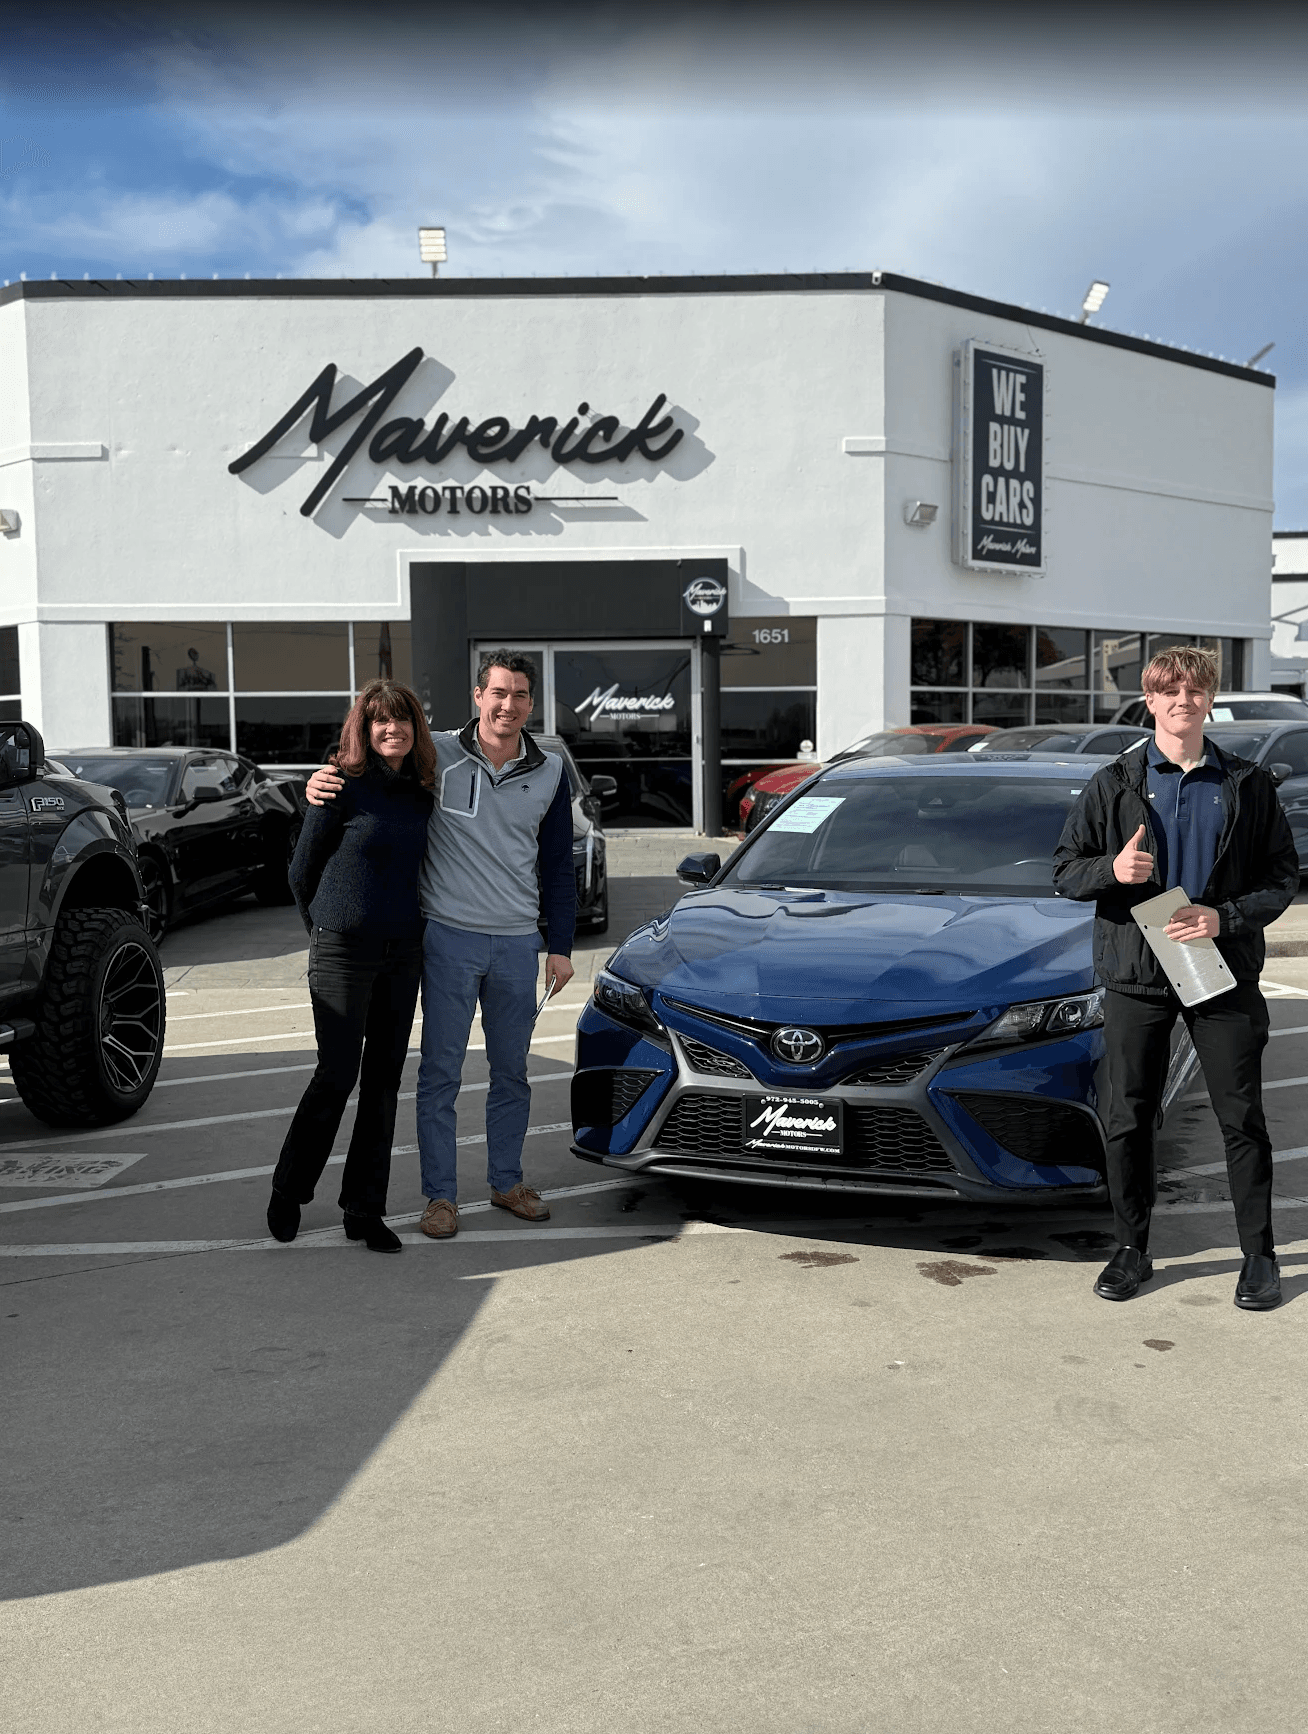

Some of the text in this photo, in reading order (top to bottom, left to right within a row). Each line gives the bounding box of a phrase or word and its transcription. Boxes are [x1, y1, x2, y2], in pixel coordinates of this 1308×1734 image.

[991, 367, 1027, 420] WE
[228, 346, 684, 517] Maverick
[988, 421, 1030, 473] BUY
[388, 485, 533, 515] MOTORS
[981, 474, 1034, 526] CARS
[752, 628, 789, 643] 1651
[574, 682, 675, 722] Maverick
[609, 712, 641, 720] MOTORS
[750, 1103, 837, 1136] Maverick
[780, 1130, 807, 1138] MOTORS
